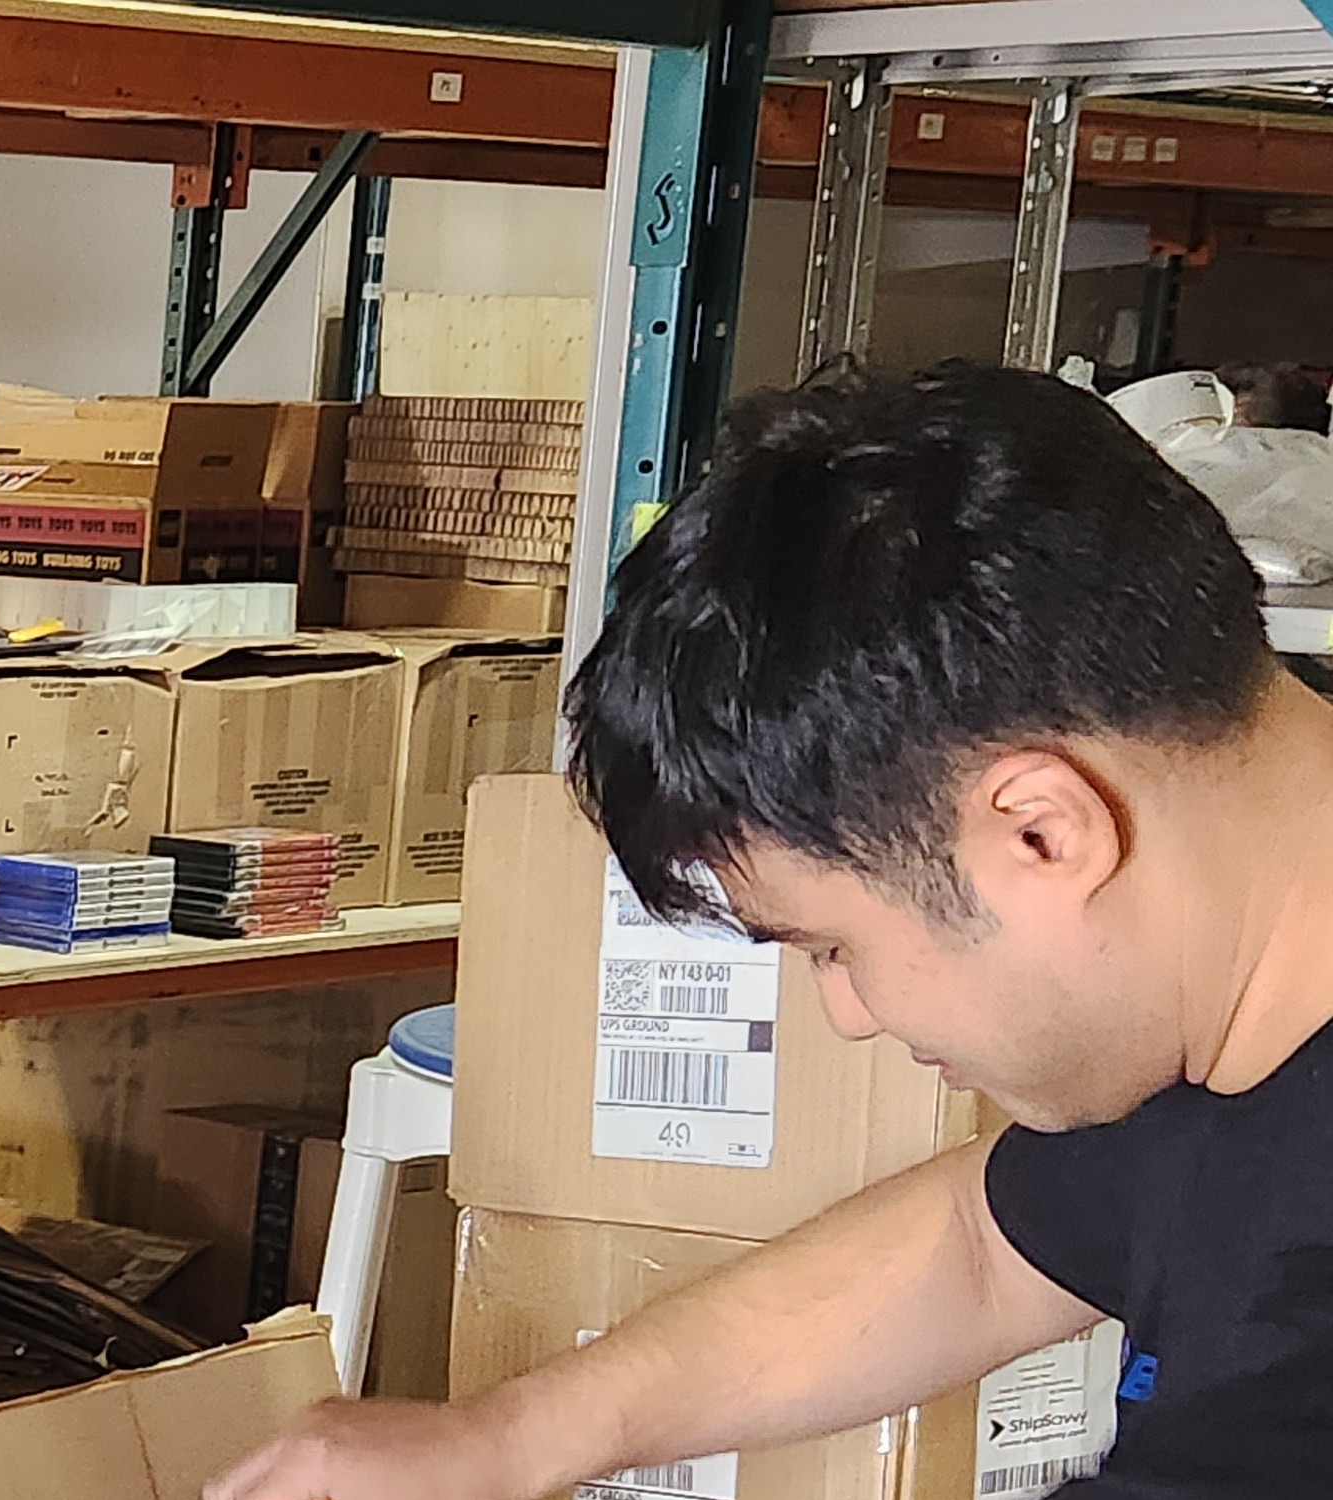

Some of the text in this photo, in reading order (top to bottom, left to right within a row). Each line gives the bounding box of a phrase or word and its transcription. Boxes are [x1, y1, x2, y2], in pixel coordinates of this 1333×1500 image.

[659, 963, 677, 981] NY
[680, 963, 702, 982] 143
[600, 1018, 670, 1033] UPS GROUND
